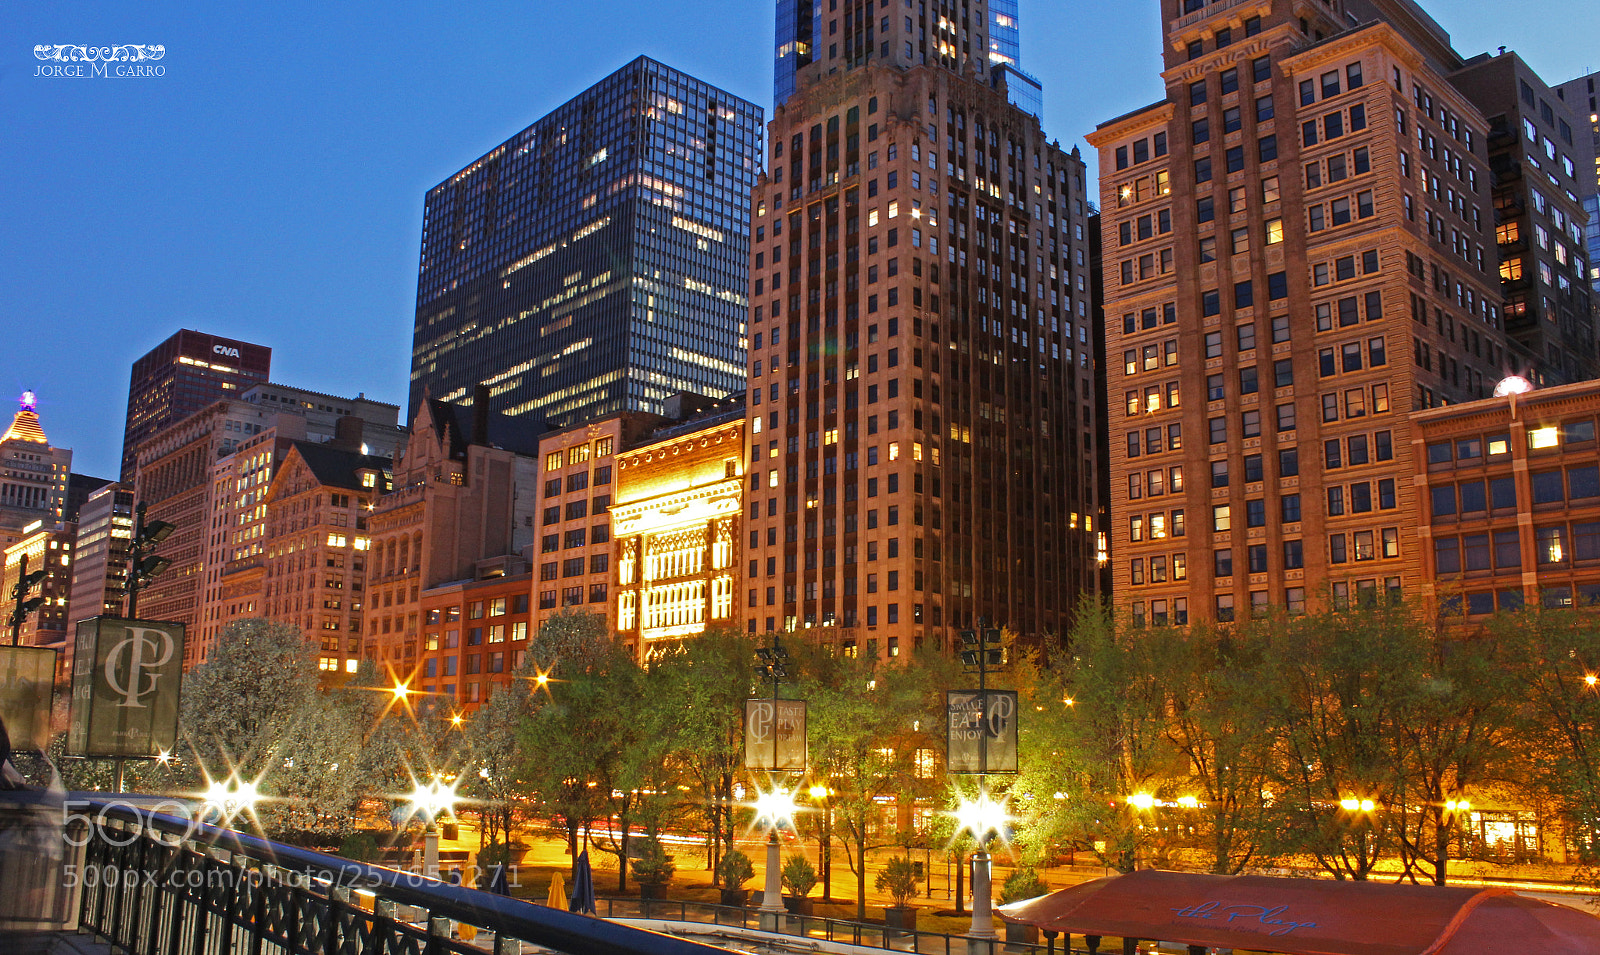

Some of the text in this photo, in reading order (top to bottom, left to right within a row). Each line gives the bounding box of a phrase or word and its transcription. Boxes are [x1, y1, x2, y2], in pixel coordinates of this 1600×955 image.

[212, 344, 240, 358] CNA
[950, 699, 983, 711] SMILE
[778, 706, 804, 717] TASTE
[777, 719, 802, 730] PLAY
[951, 712, 982, 728] EAT
[950, 730, 983, 742] ENJOY
[1170, 901, 1322, 936] the Plaza
